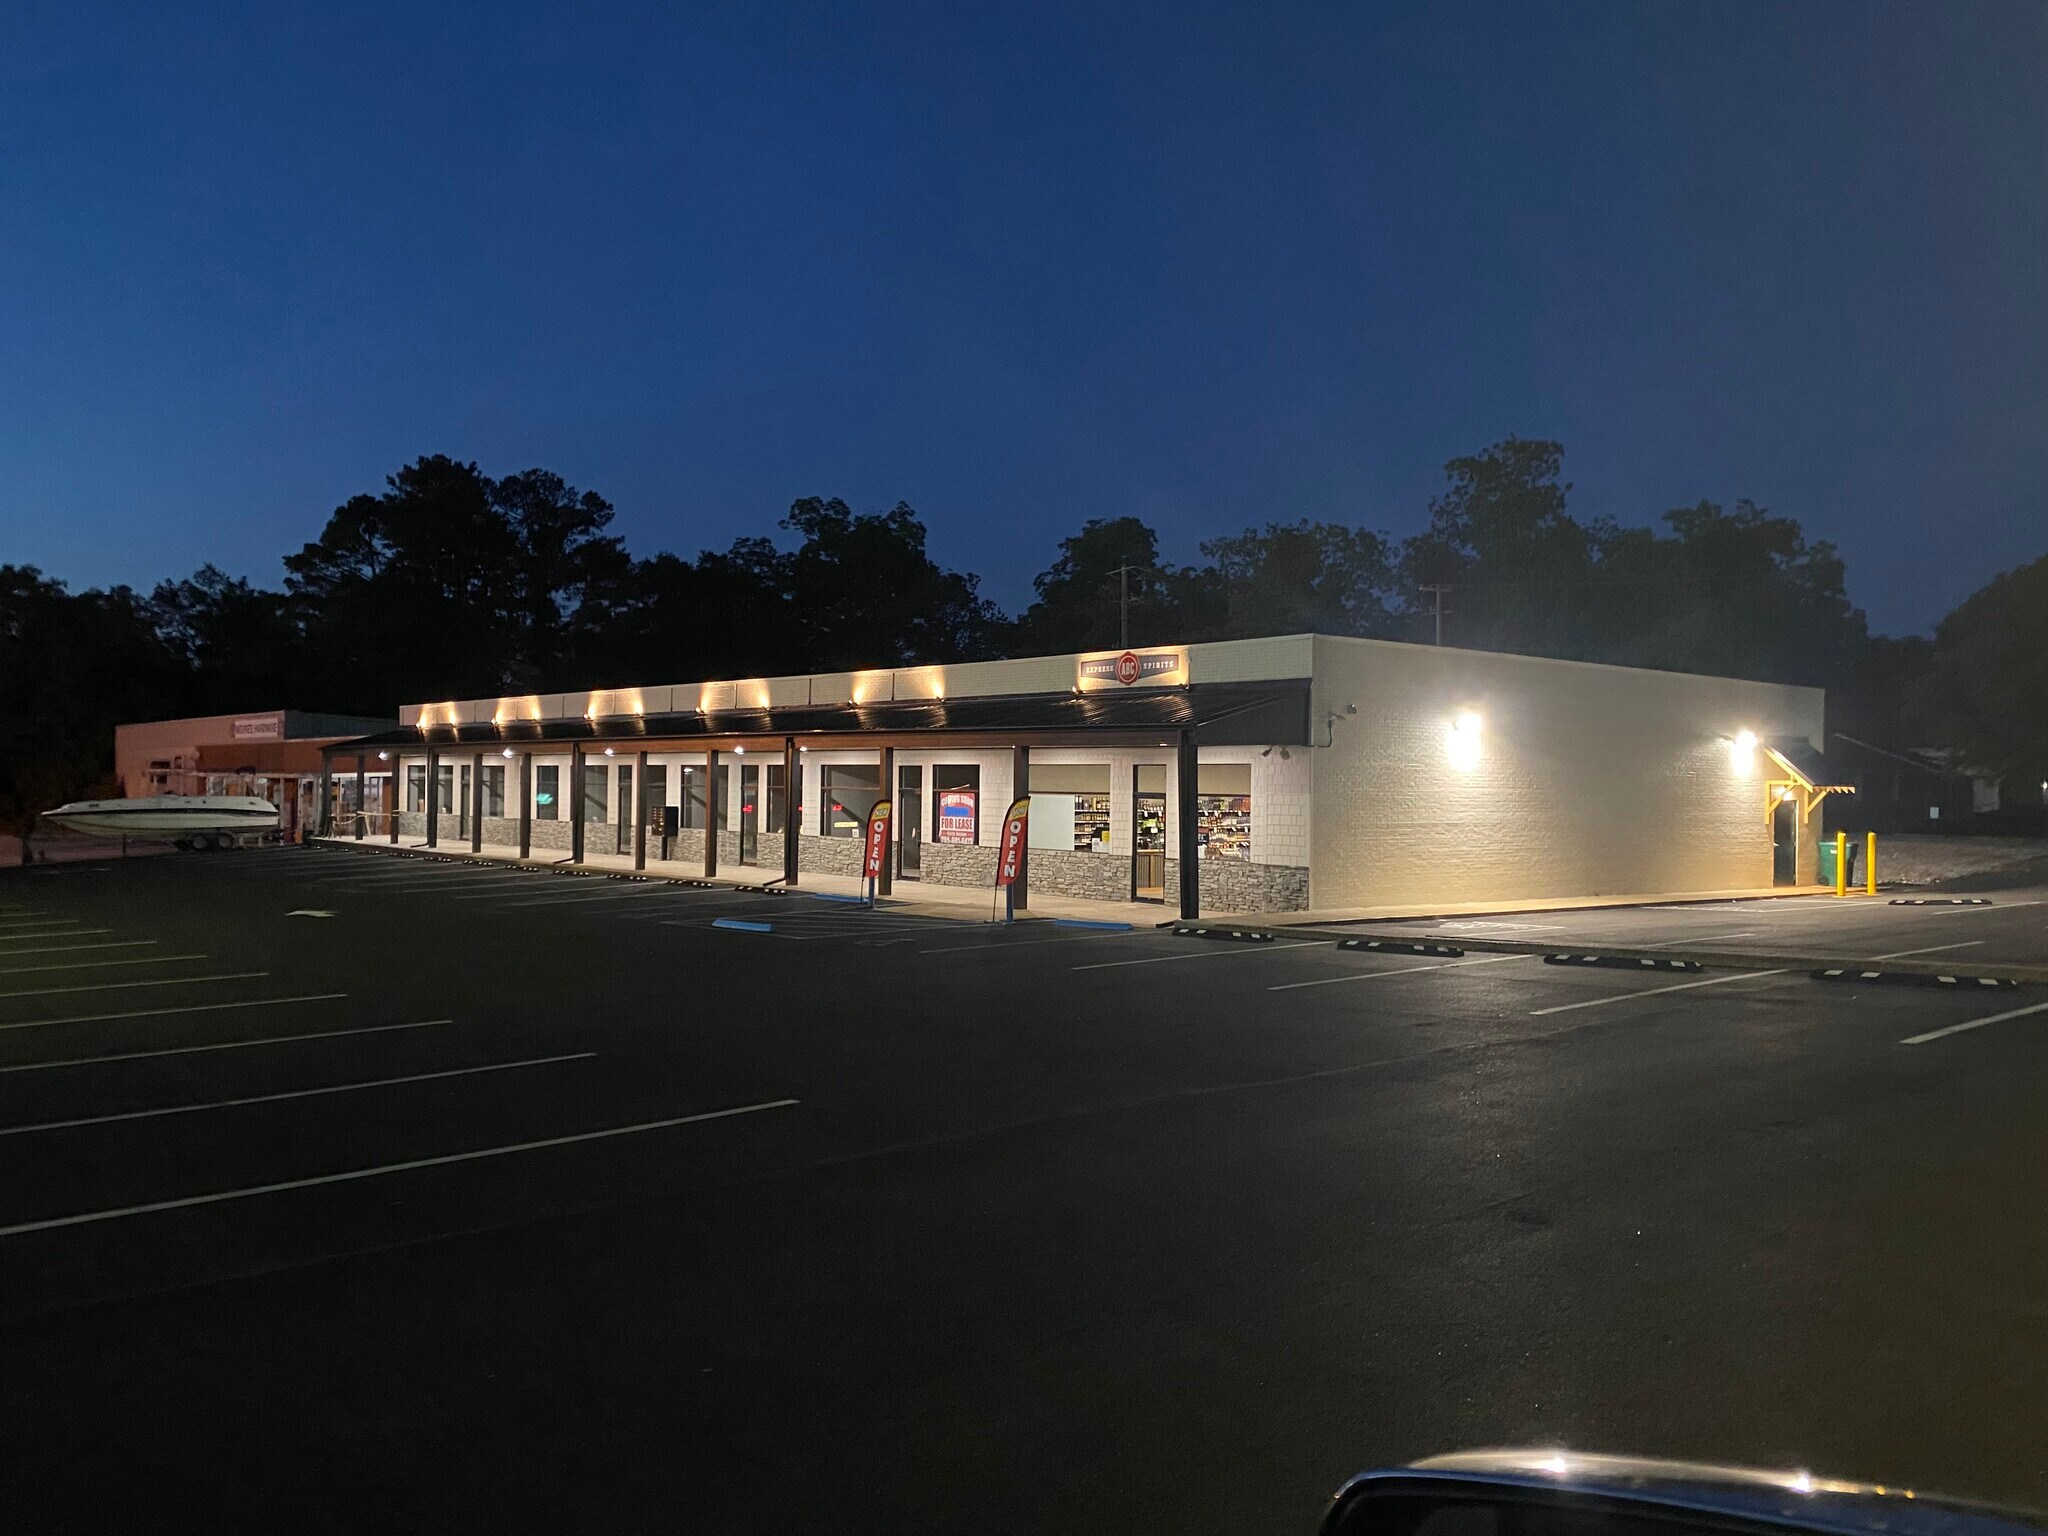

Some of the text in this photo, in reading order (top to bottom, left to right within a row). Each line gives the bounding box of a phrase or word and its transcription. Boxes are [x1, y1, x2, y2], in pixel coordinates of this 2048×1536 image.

[1085, 660, 1175, 676] EXPRESS ABC SPIRITS
[941, 817, 973, 830] FOR LEASE
[869, 820, 885, 871] OPEN
[1004, 820, 1022, 877] OPEN
